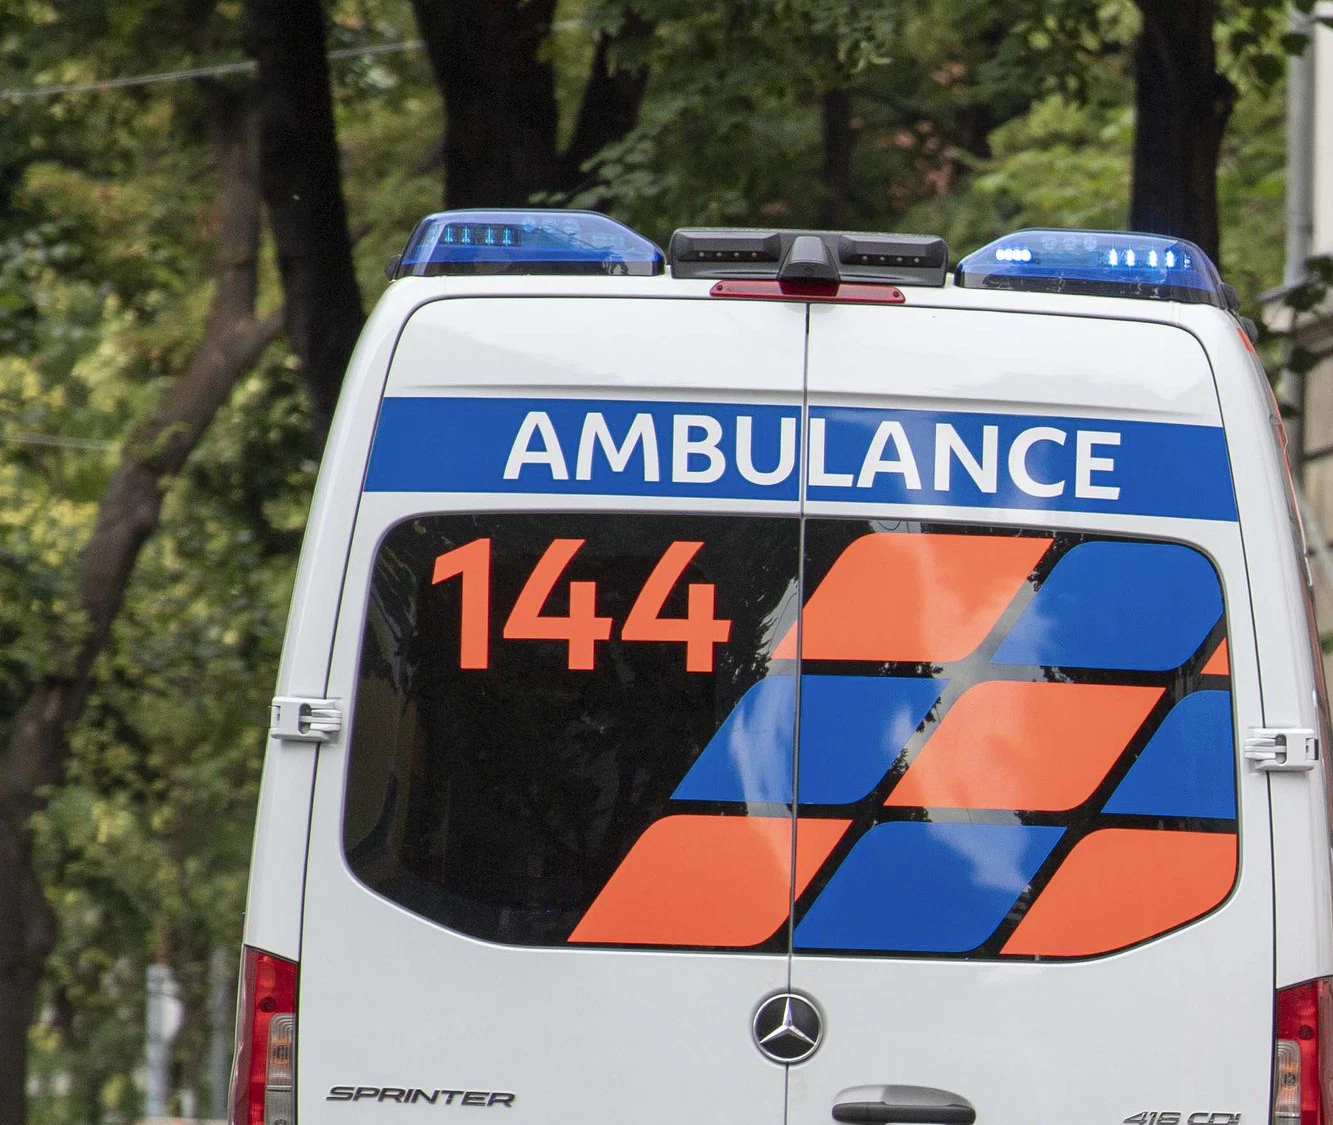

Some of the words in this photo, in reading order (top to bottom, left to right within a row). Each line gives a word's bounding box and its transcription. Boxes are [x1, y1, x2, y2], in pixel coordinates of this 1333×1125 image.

[502, 411, 1124, 501] AMBULANCE
[431, 537, 733, 673] 144
[326, 1086, 516, 1108] SPRINTER
[1122, 1111, 1182, 1125] 416
